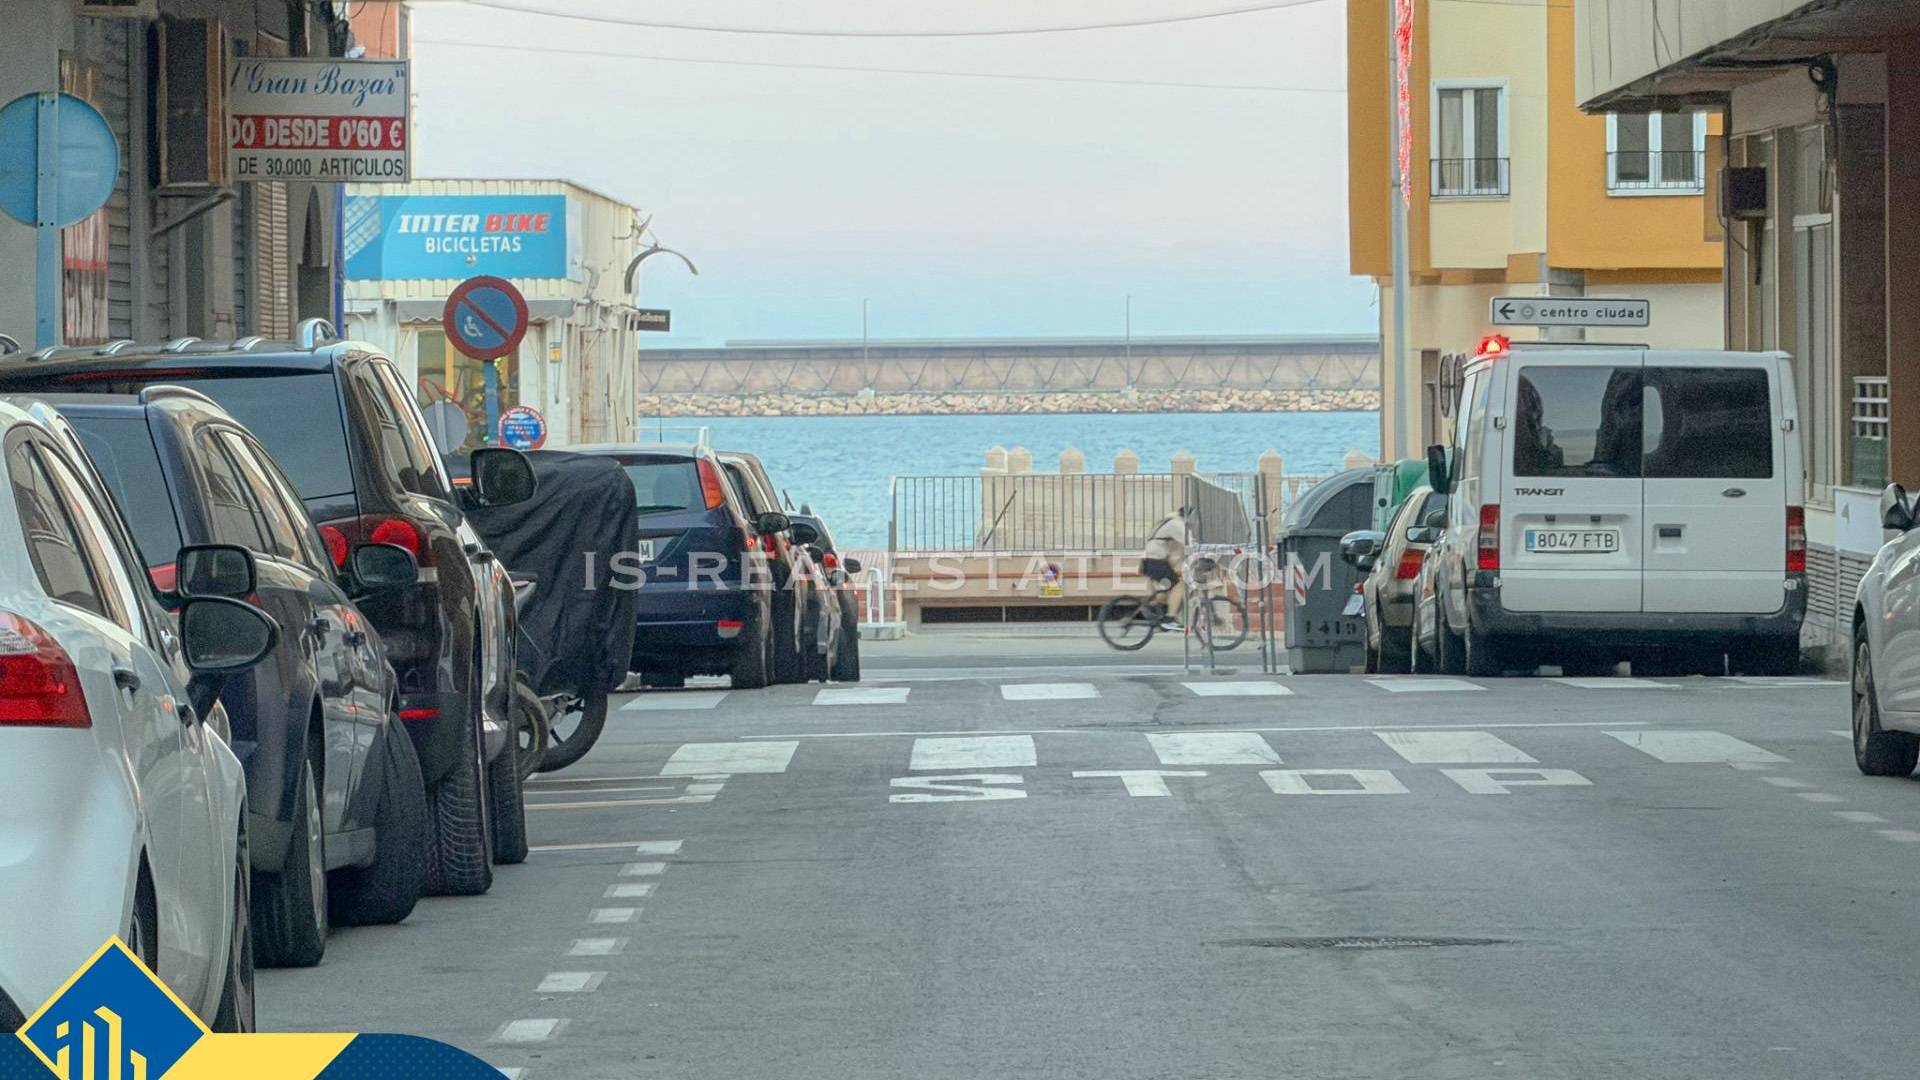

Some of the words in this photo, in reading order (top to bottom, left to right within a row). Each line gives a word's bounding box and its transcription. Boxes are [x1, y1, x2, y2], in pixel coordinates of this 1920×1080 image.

[314, 62, 405, 108] Bazar"
[264, 118, 330, 146] DESDE
[389, 120, 402, 147] €
[238, 157, 257, 174] DE
[265, 158, 311, 175] 30.000
[319, 158, 404, 176] ARTICULOS
[398, 214, 480, 233] INTER
[484, 213, 550, 233] BIKE
[425, 236, 521, 253] BICICLETAS
[1540, 307, 1588, 318] centro
[1595, 307, 1644, 319] ciudad
[1514, 487, 1566, 496] TRANSIT
[1537, 533, 1578, 548] 8047
[1583, 533, 1615, 548] FTB
[889, 769, 1593, 802] STOP
